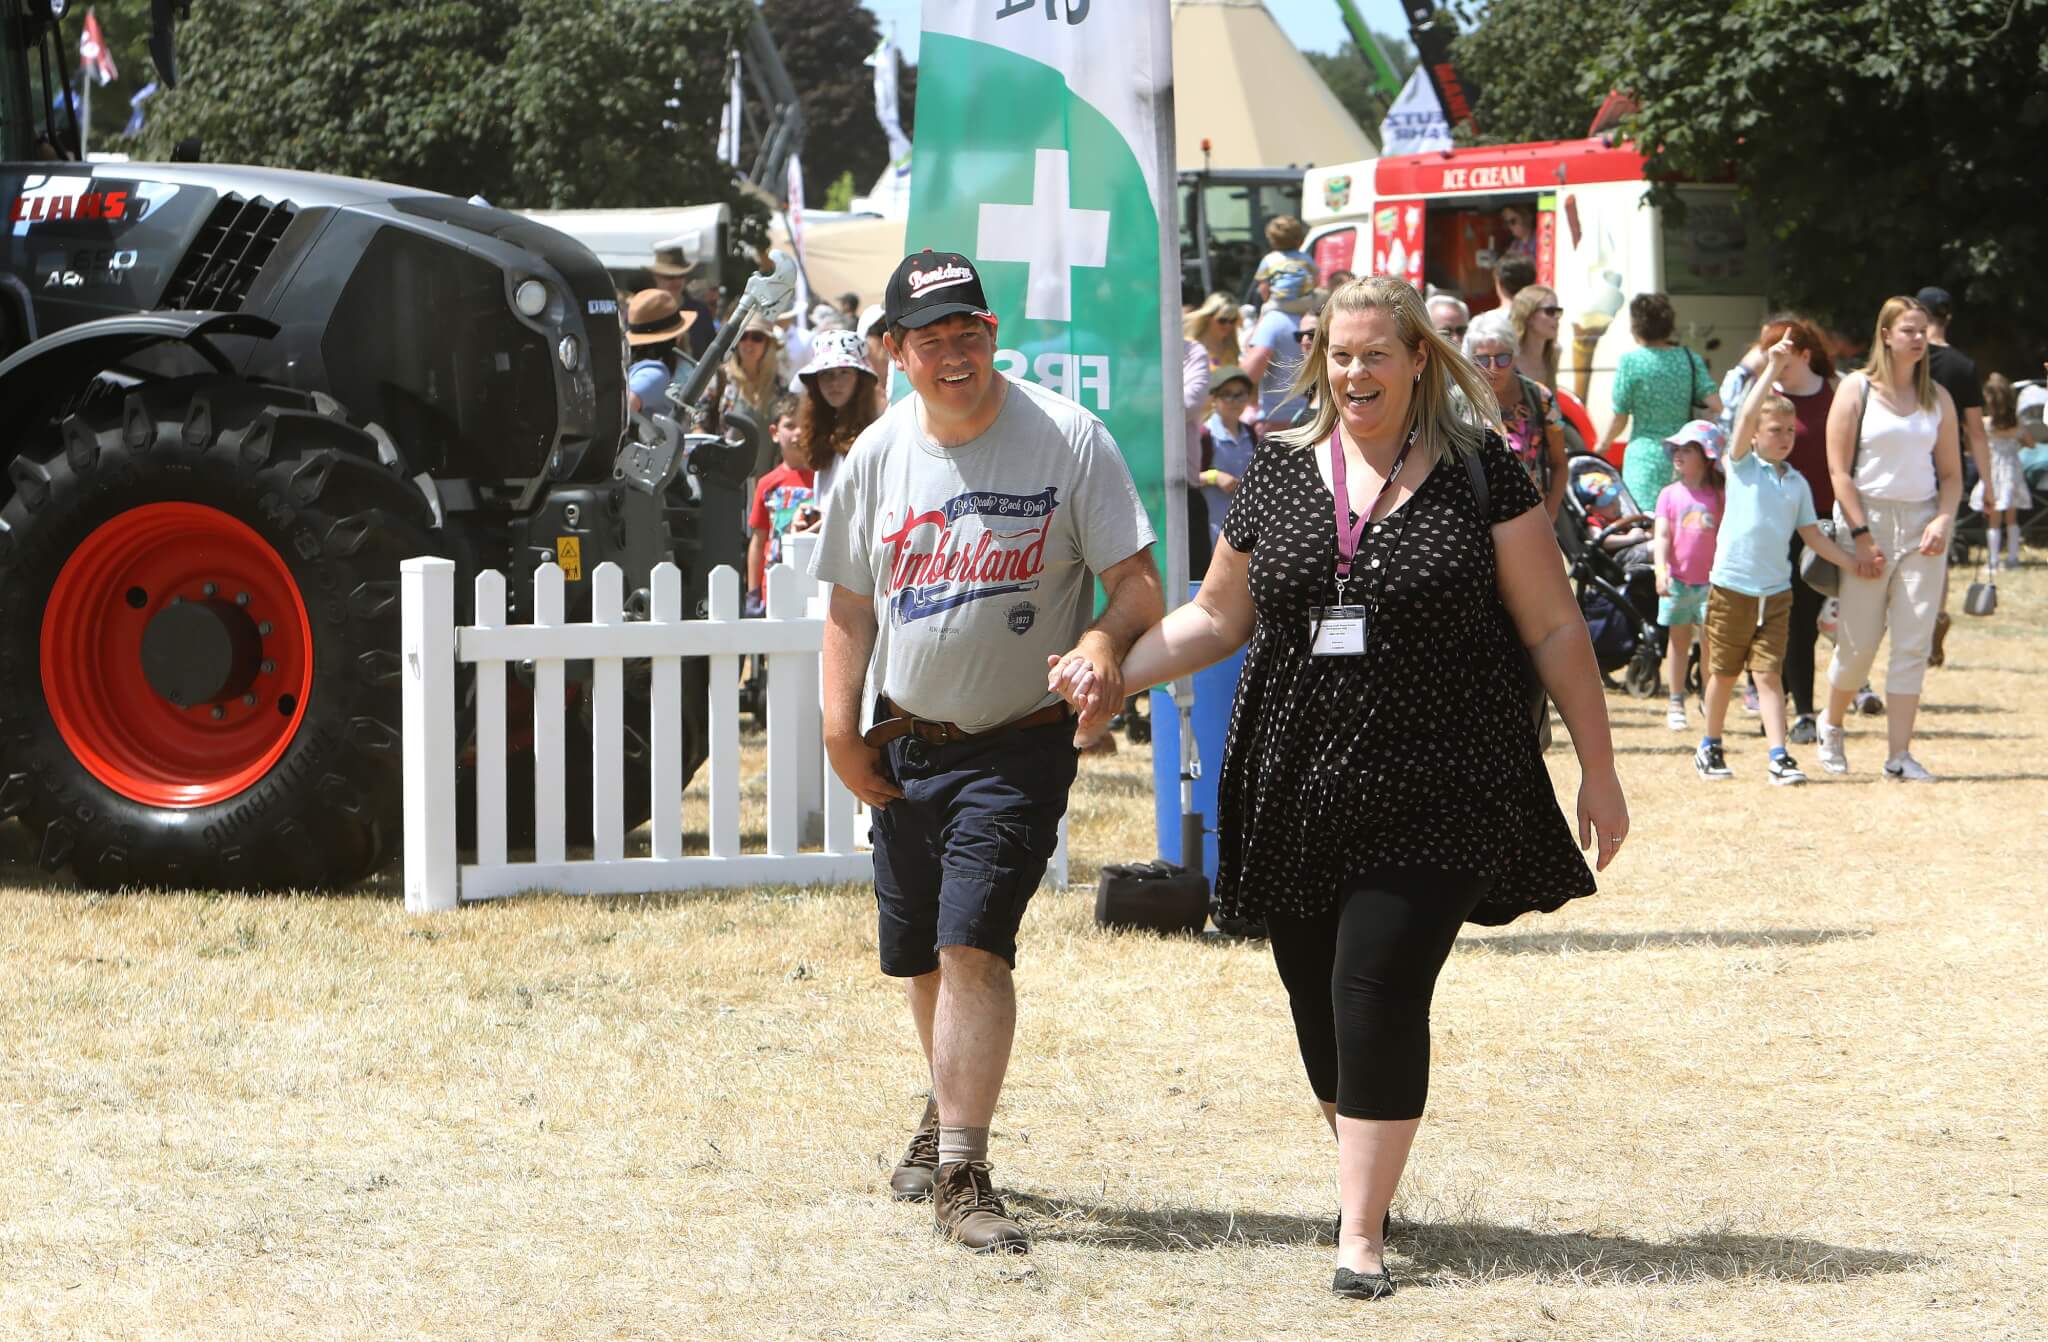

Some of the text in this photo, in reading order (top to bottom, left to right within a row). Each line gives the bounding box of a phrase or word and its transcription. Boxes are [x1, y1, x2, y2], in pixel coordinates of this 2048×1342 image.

[1443, 165, 1525, 190] ICE CREAM
[9, 191, 128, 223] CLAAS
[953, 499, 968, 517] Be
[999, 498, 1021, 514] Each
[1023, 500, 1047, 517] Day
[881, 505, 1055, 597] Timberland
